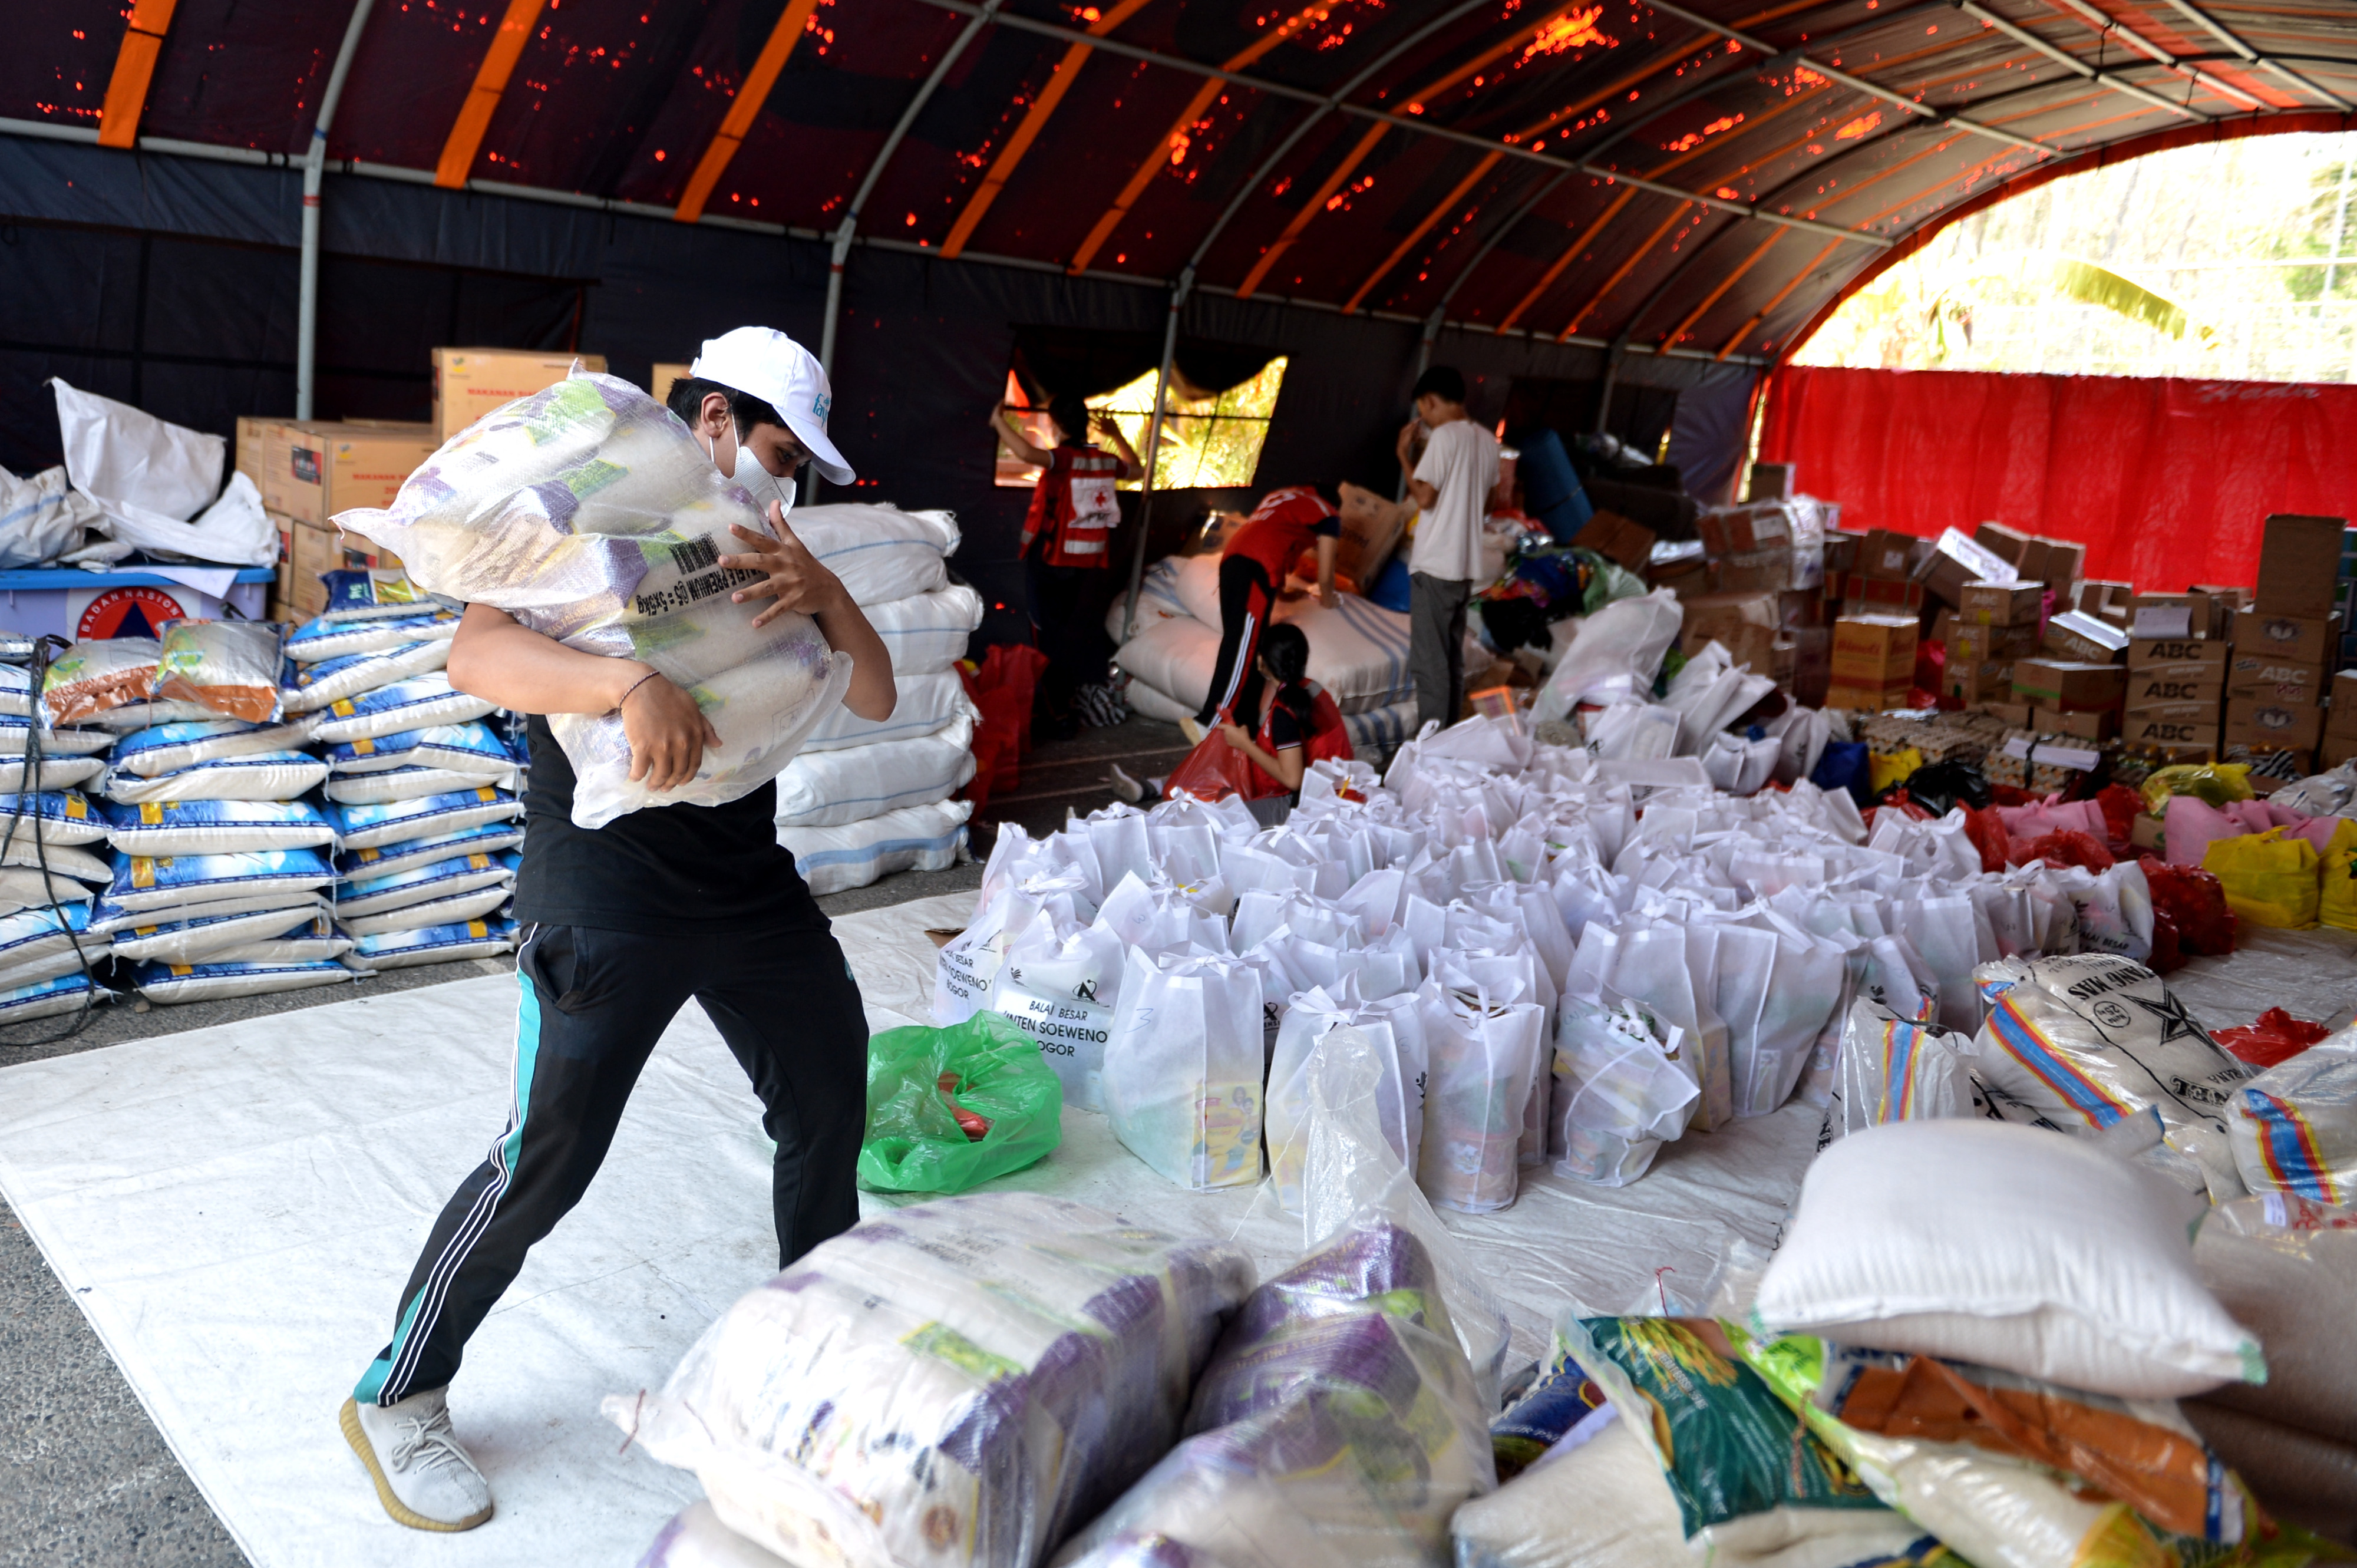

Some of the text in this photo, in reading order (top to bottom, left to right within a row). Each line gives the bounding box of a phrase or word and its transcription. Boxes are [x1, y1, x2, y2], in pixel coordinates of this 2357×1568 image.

[674, 580, 689, 606] @5
[686, 569, 730, 601] PREMIUM
[81, 593, 119, 632] BADAN
[2064, 636, 2102, 660] ABC
[2148, 642, 2203, 659] ABC
[2257, 666, 2309, 684] ABC
[2144, 682, 2198, 699] ABC
[2140, 724, 2196, 742] ABC
[2067, 976, 2114, 1001] MAS
[1029, 1001, 1088, 1021] BALAI BESAR
[2104, 1004, 2120, 1016] 25
[1124, 1008, 1154, 1034] 3
[1036, 1040, 1075, 1058] OGOR
